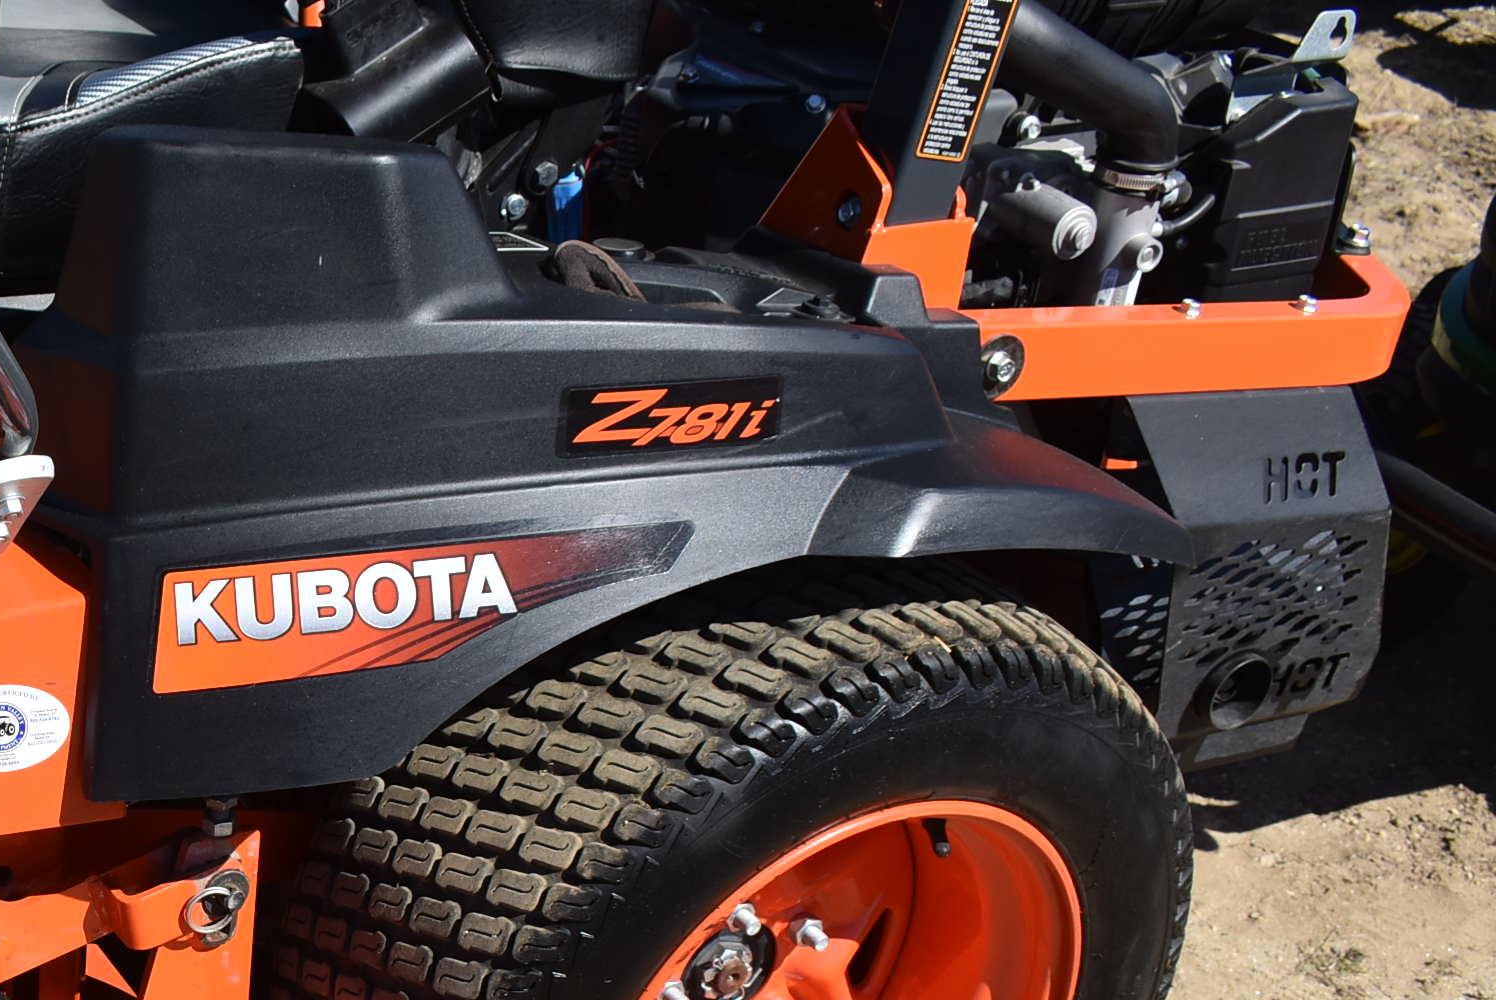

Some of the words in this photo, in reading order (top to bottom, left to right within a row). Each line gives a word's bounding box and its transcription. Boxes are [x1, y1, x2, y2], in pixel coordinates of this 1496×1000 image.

[572, 389, 775, 446] Z781i
[1263, 451, 1346, 505] HOT
[173, 552, 518, 646] KUBOTA
[1272, 652, 1351, 697] HOT
